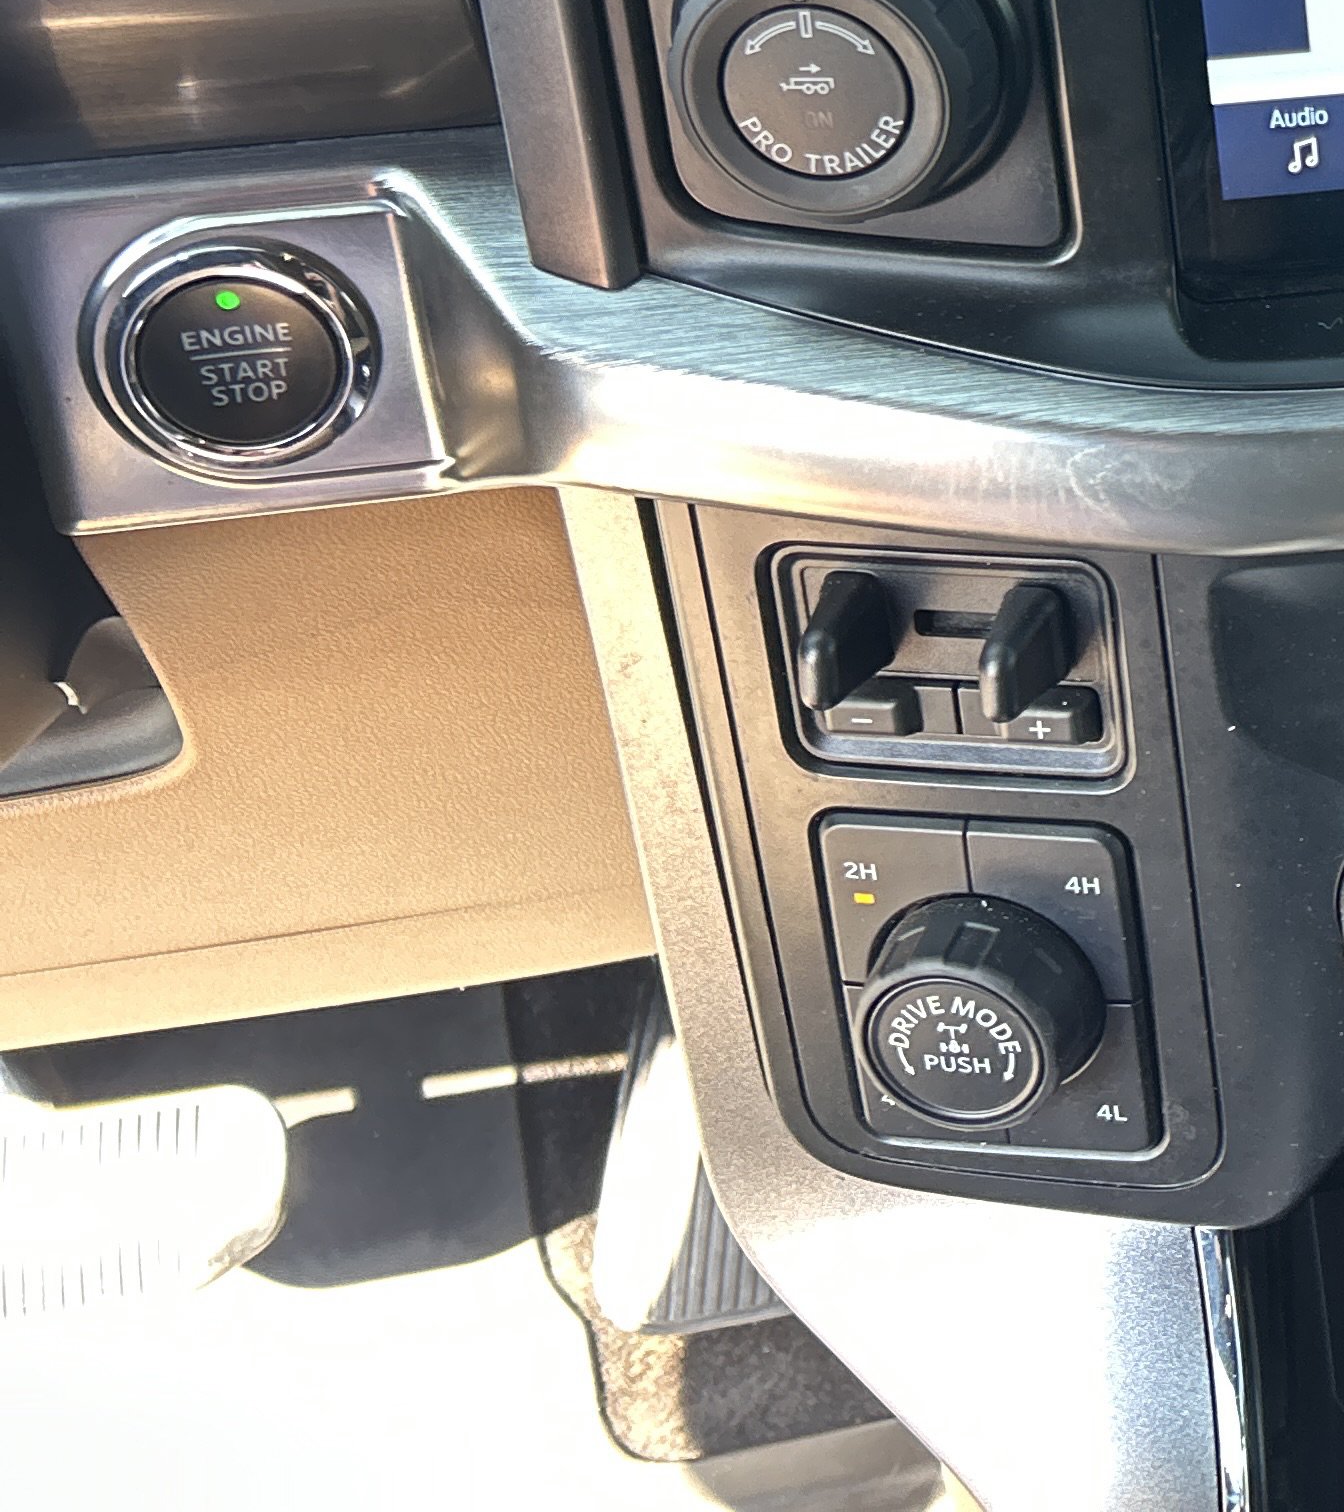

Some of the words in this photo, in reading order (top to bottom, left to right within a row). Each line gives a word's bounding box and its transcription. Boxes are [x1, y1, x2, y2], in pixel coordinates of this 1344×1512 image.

[1269, 106, 1330, 131] Audio
[738, 115, 794, 165] PRO
[805, 114, 905, 175] TRAILER
[180, 322, 293, 352] ENGINE
[199, 357, 289, 386] START
[211, 380, 288, 407] STOP
[843, 860, 878, 882] 2H
[1064, 875, 1101, 896] 4H
[888, 995, 945, 1049] DRIVE
[951, 996, 1022, 1055] MODE
[923, 1054, 992, 1074] PUSH
[1096, 1104, 1129, 1123] 4L
